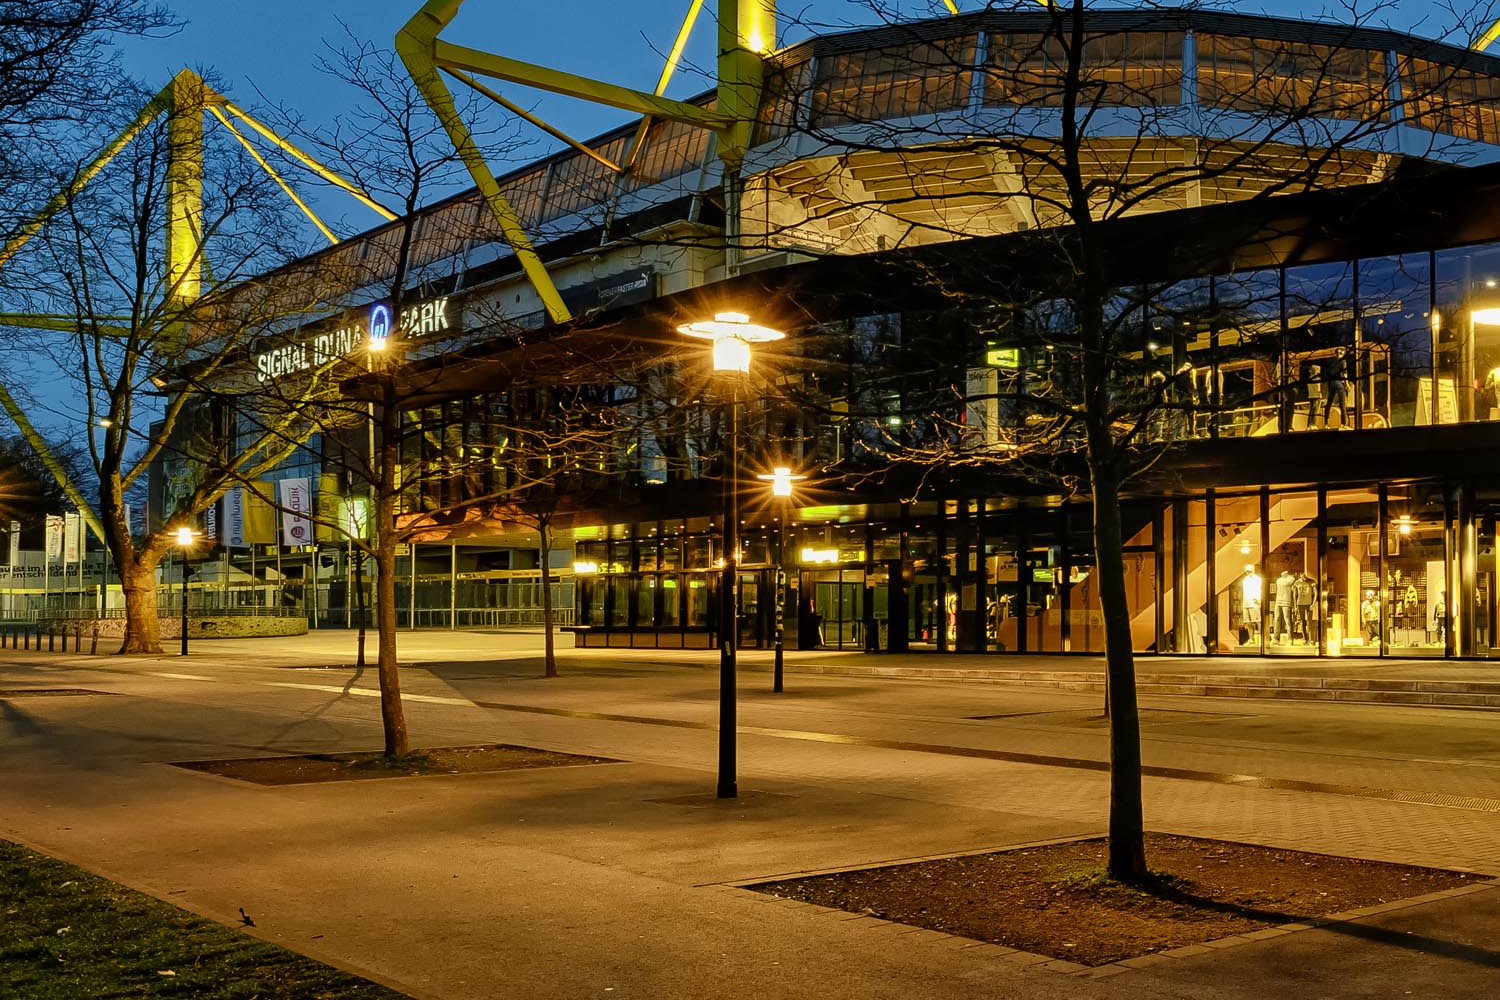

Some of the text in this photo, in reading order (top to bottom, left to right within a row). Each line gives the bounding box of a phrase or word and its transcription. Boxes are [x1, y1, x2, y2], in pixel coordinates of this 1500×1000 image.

[256, 296, 449, 382] SIGNAL IDUNA PARK
[12, 570, 77, 579] entschidend
